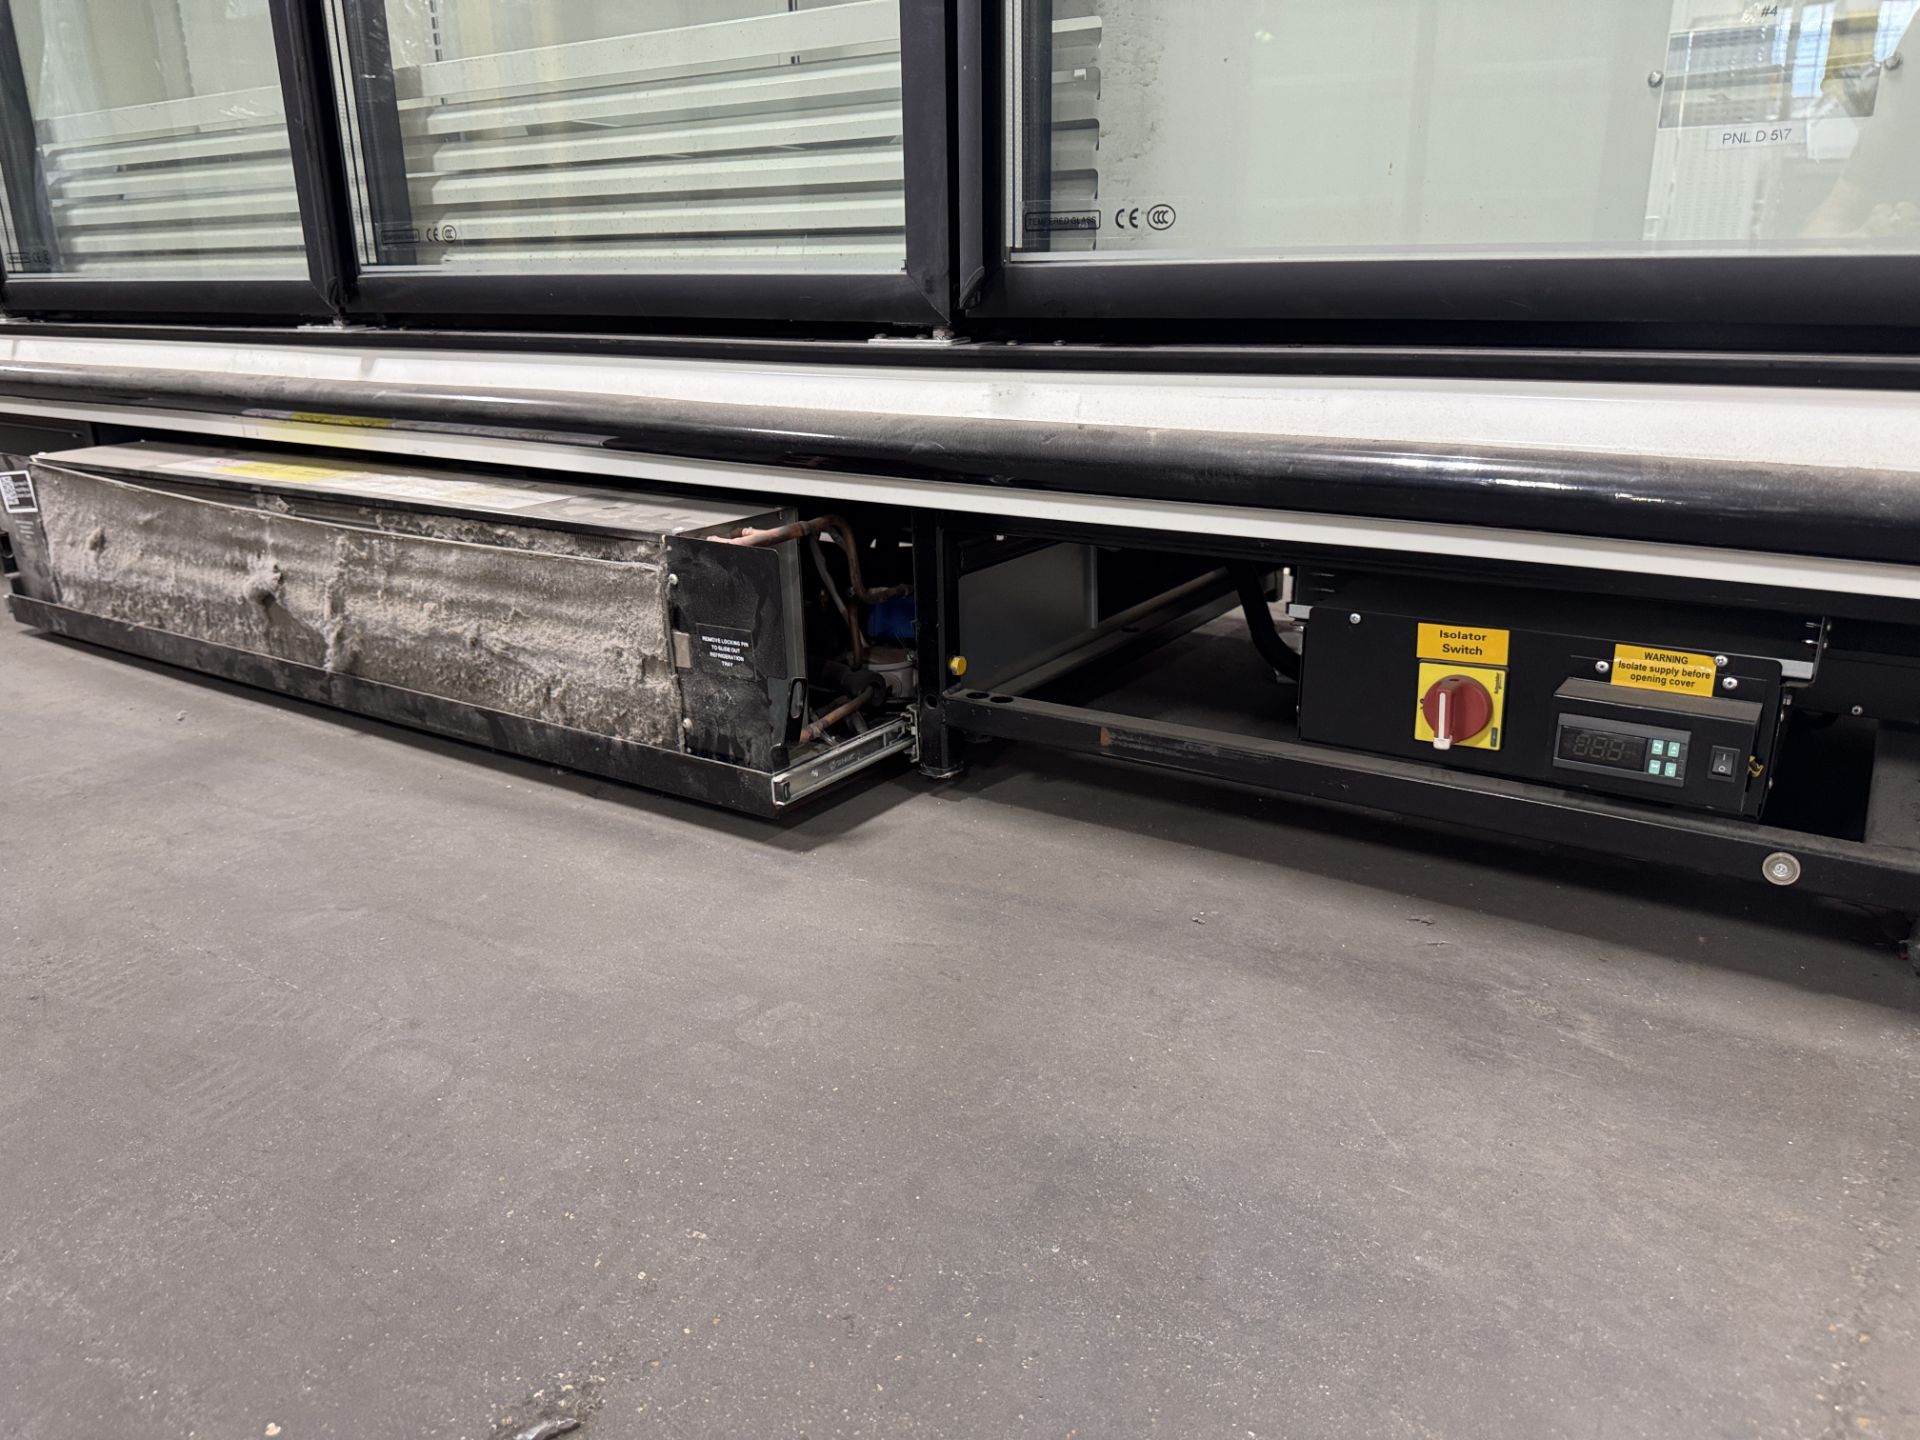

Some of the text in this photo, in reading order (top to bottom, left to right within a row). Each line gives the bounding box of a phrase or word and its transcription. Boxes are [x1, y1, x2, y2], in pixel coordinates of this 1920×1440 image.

[1761, 5, 1778, 17] #4
[1722, 132, 1751, 145] PNL
[1756, 130, 1767, 143] D
[1071, 216, 1097, 225] GLASS
[1115, 208, 1139, 229] CE
[1439, 630, 1487, 641] Isolator
[721, 638, 740, 647] LOCKING
[1442, 643, 1483, 656] Switch
[1644, 651, 1689, 665] WARNING
[1618, 660, 1711, 680] Isolate supply before
[1630, 673, 1695, 688] opening cover
